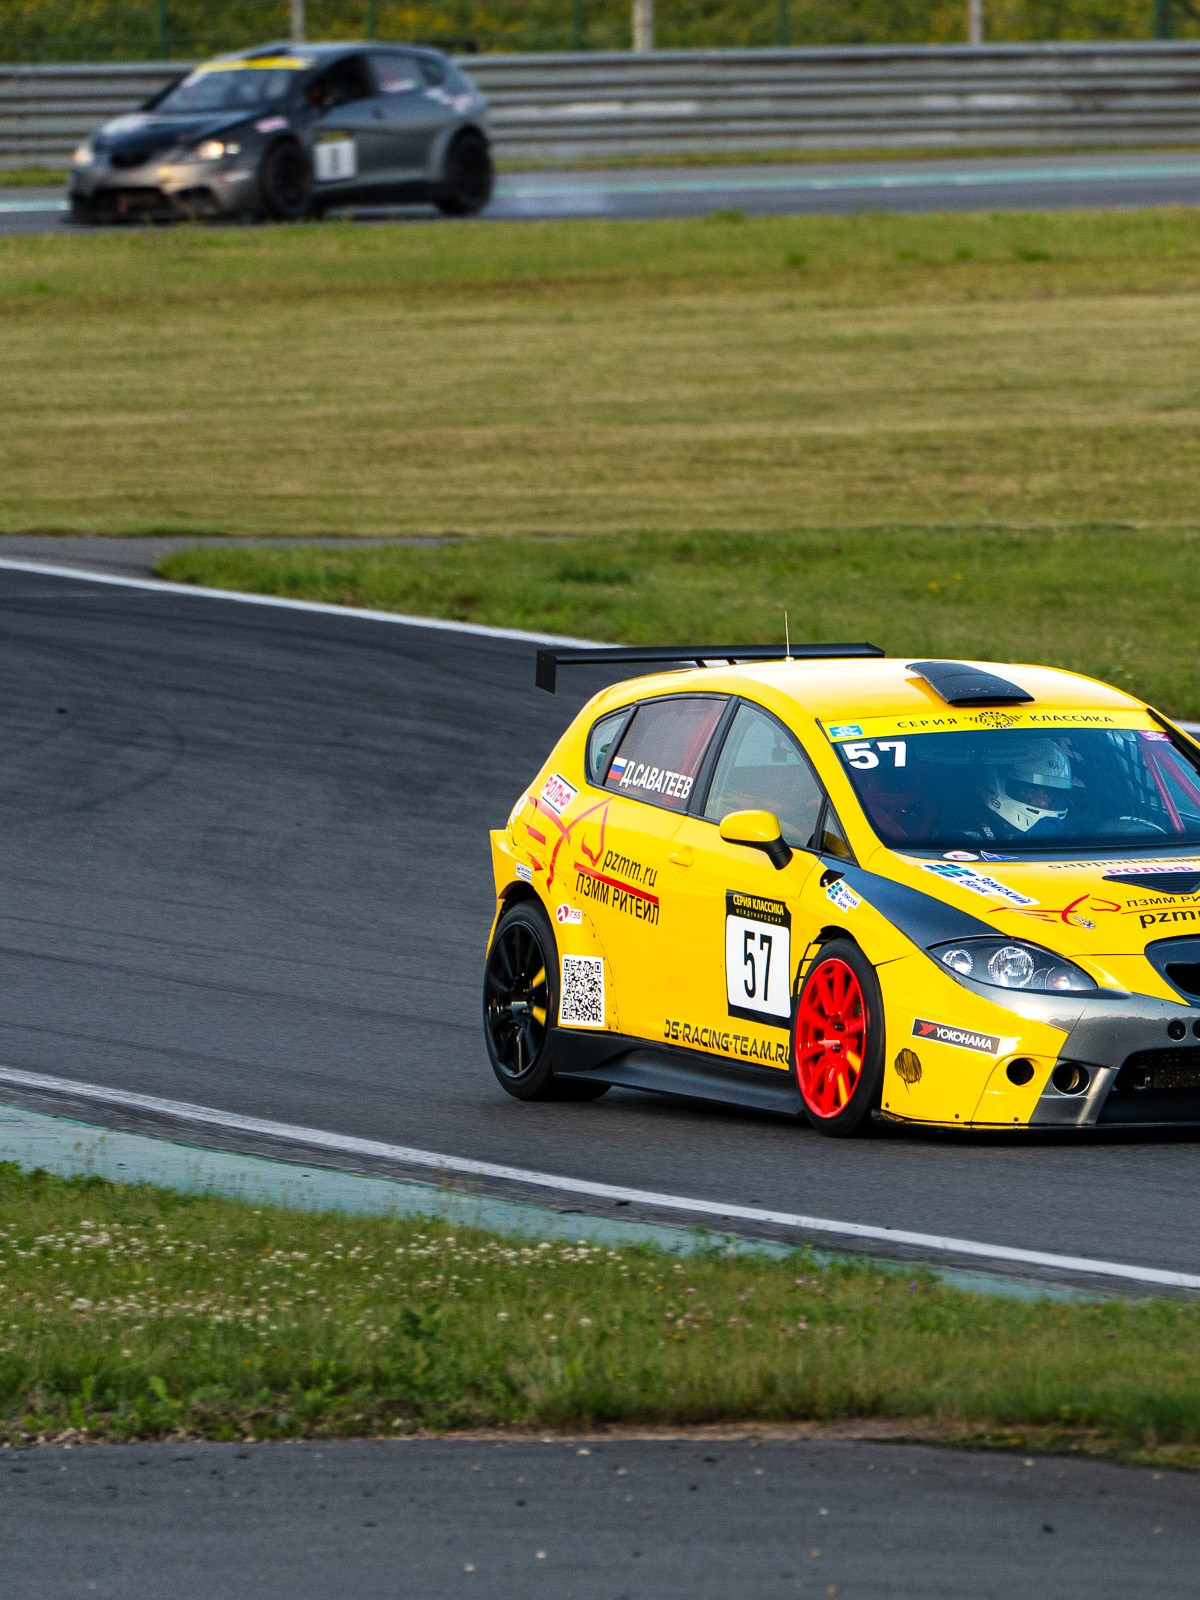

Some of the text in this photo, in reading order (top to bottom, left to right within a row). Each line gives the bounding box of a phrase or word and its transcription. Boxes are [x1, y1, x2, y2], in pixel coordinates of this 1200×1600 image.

[897, 714, 1115, 729] СЕРИЯ КЛАССИКА
[842, 741, 907, 769] 57
[543, 776, 571, 807] РОЛЬФ
[619, 760, 694, 799] Д.САВАТЕЕВ
[602, 849, 658, 887] pzmm.ru
[1105, 866, 1194, 874] РОЛЬФ
[575, 872, 660, 925] ПЗММ РИТЕЙЛ
[733, 894, 785, 916] СЕРИЯ КЛАССИКА
[1126, 896, 1178, 908] ПЗММ
[743, 930, 773, 1002] 57
[936, 1027, 992, 1050] YOKOHAMA
